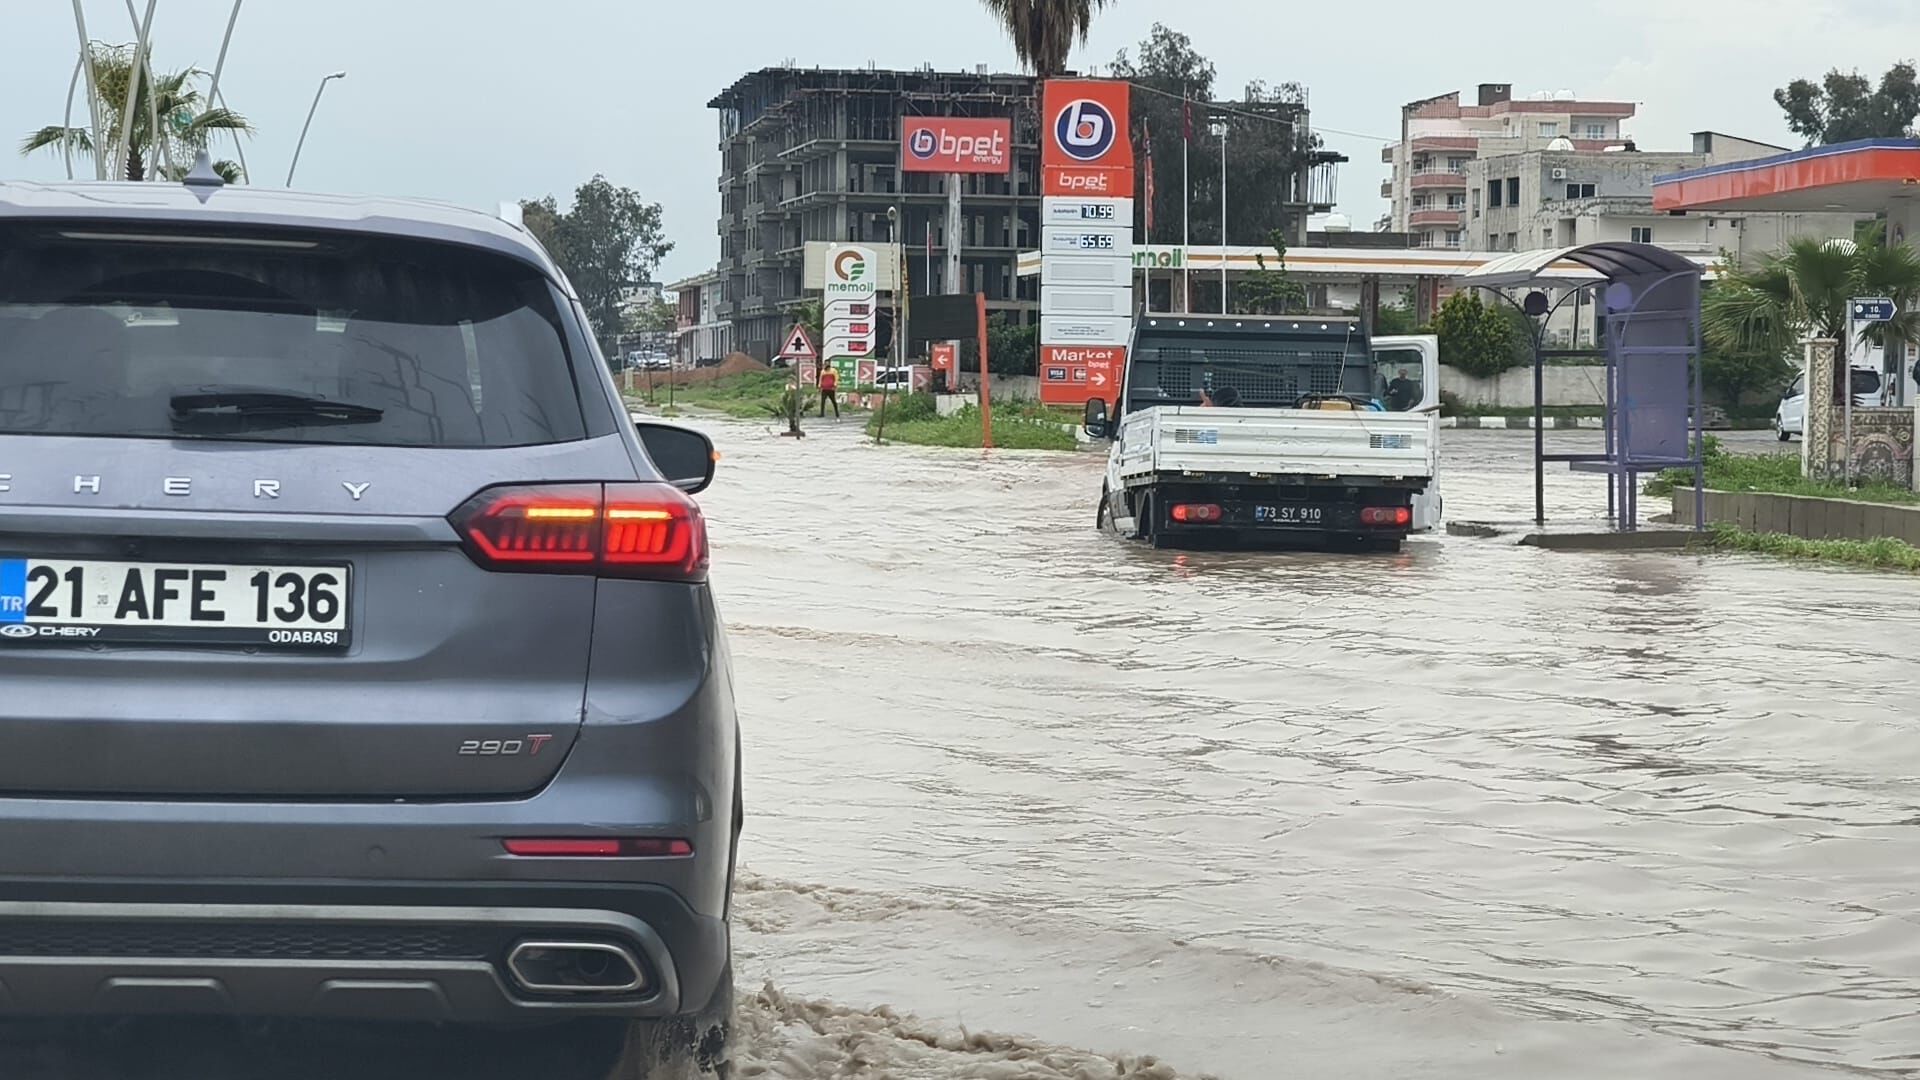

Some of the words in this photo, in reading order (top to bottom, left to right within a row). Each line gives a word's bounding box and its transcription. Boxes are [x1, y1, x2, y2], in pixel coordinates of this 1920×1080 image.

[939, 128, 1004, 162] bpet
[1059, 172, 1108, 190] bpet
[1082, 204, 1114, 218] 70.99
[828, 282, 874, 293] memoil
[1051, 349, 1113, 361] Market
[1263, 506, 1276, 518] 73
[1281, 507, 1295, 518] SY
[1300, 508, 1321, 519] 910
[1, 595, 24, 612] TR
[26, 565, 84, 618] 21
[115, 568, 227, 621] AFE
[250, 571, 339, 623] 136
[39, 626, 102, 637] CHERY
[268, 629, 339, 645] ODABAŞI
